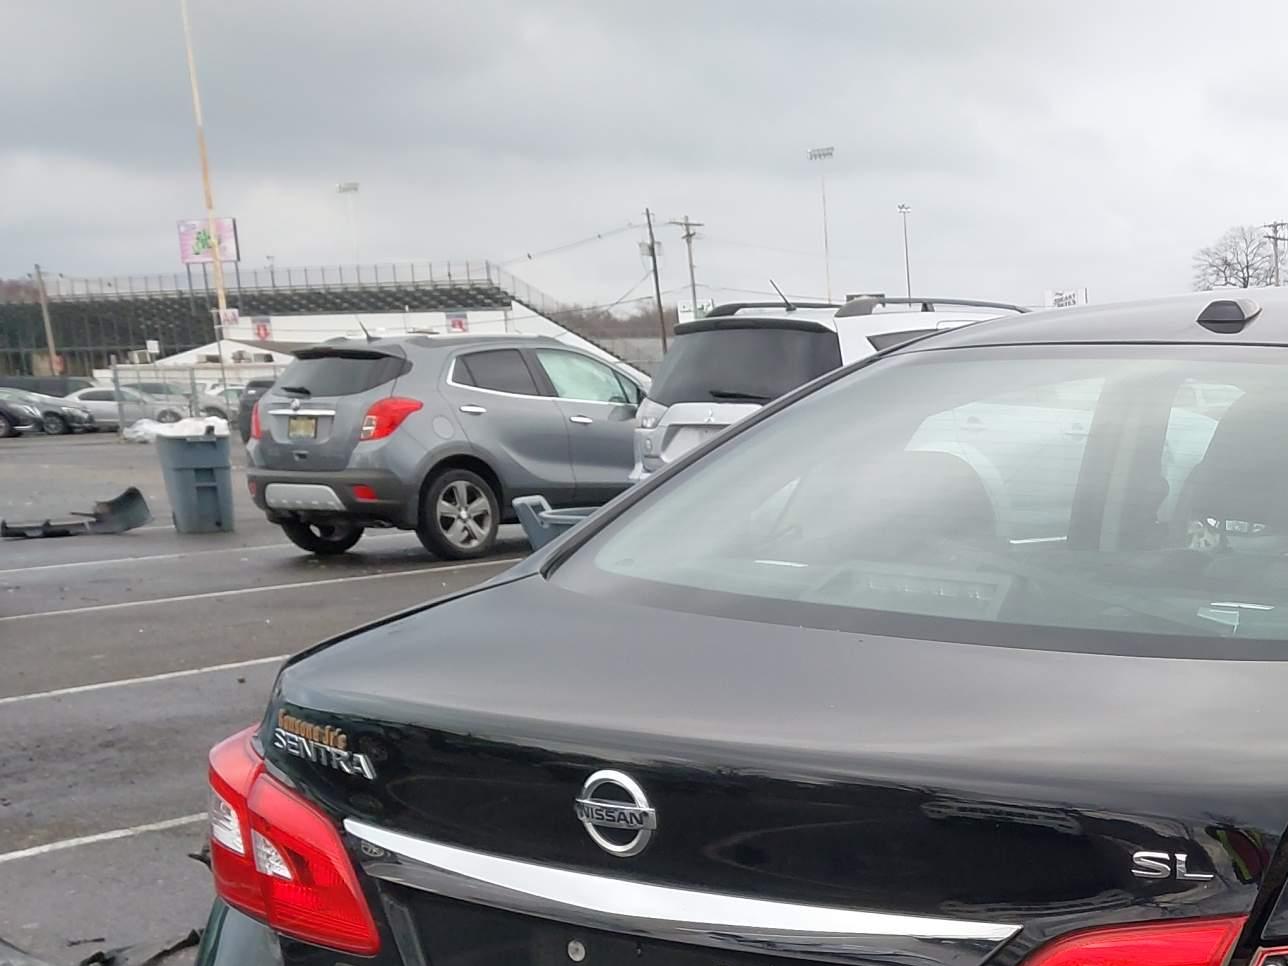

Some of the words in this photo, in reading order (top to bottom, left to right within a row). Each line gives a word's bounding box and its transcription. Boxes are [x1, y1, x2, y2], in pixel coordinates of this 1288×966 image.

[273, 727, 377, 780] SENTRA
[578, 806, 644, 826] NISSAN
[1131, 851, 1215, 881] SL
